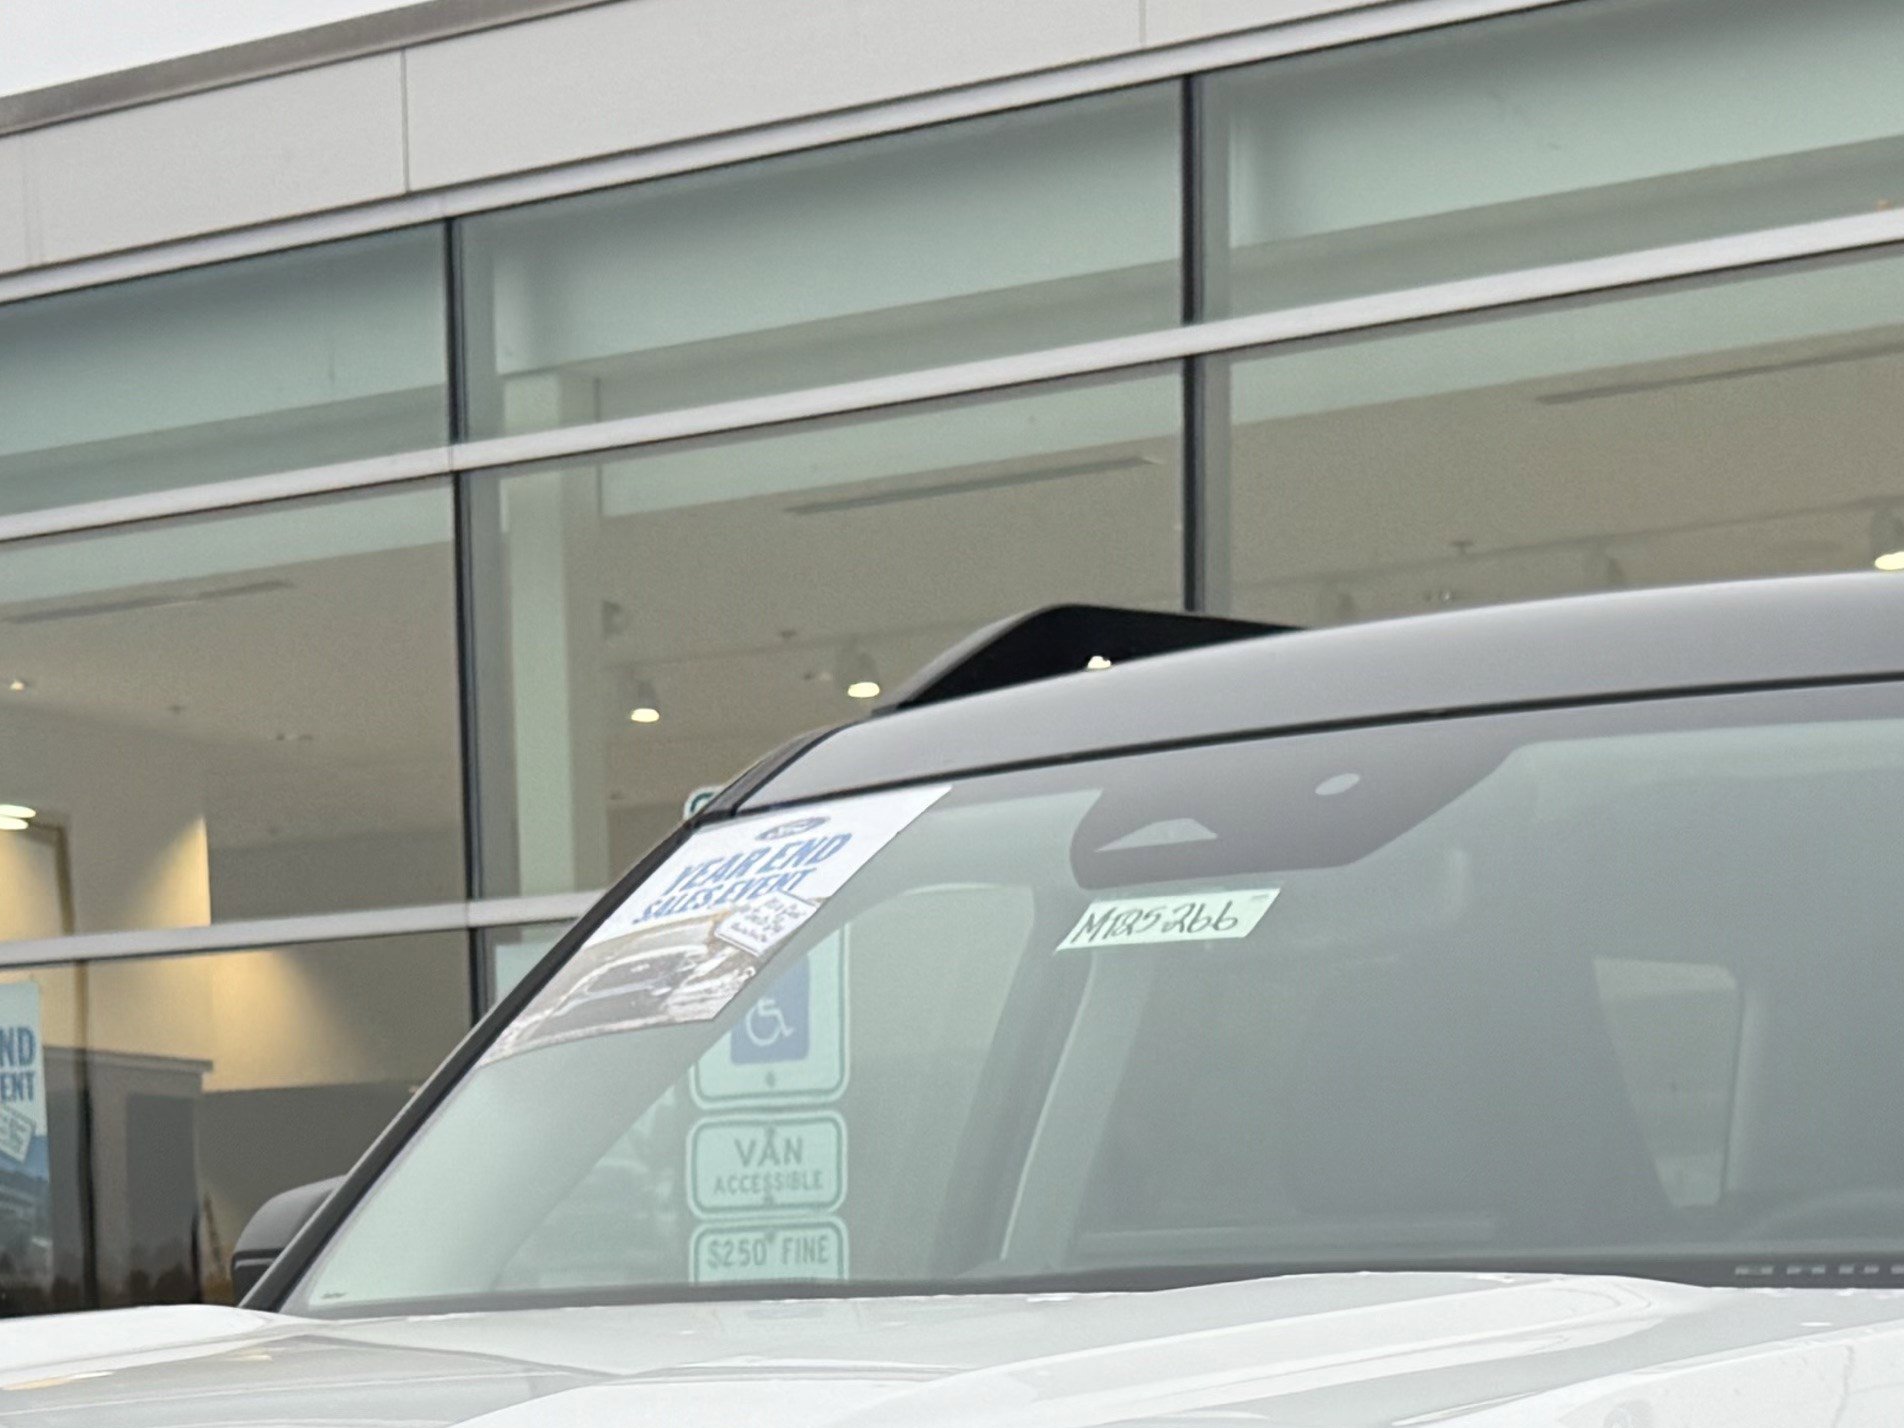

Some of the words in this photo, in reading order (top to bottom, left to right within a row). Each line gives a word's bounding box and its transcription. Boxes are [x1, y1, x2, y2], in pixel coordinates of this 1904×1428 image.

[663, 847, 771, 896] YEAR
[758, 833, 852, 872] END
[734, 1137, 804, 1167] VAN
[713, 1170, 824, 1195] ACCESSIBLE
[707, 1237, 768, 1269] $250
[781, 1235, 830, 1265] FINE
